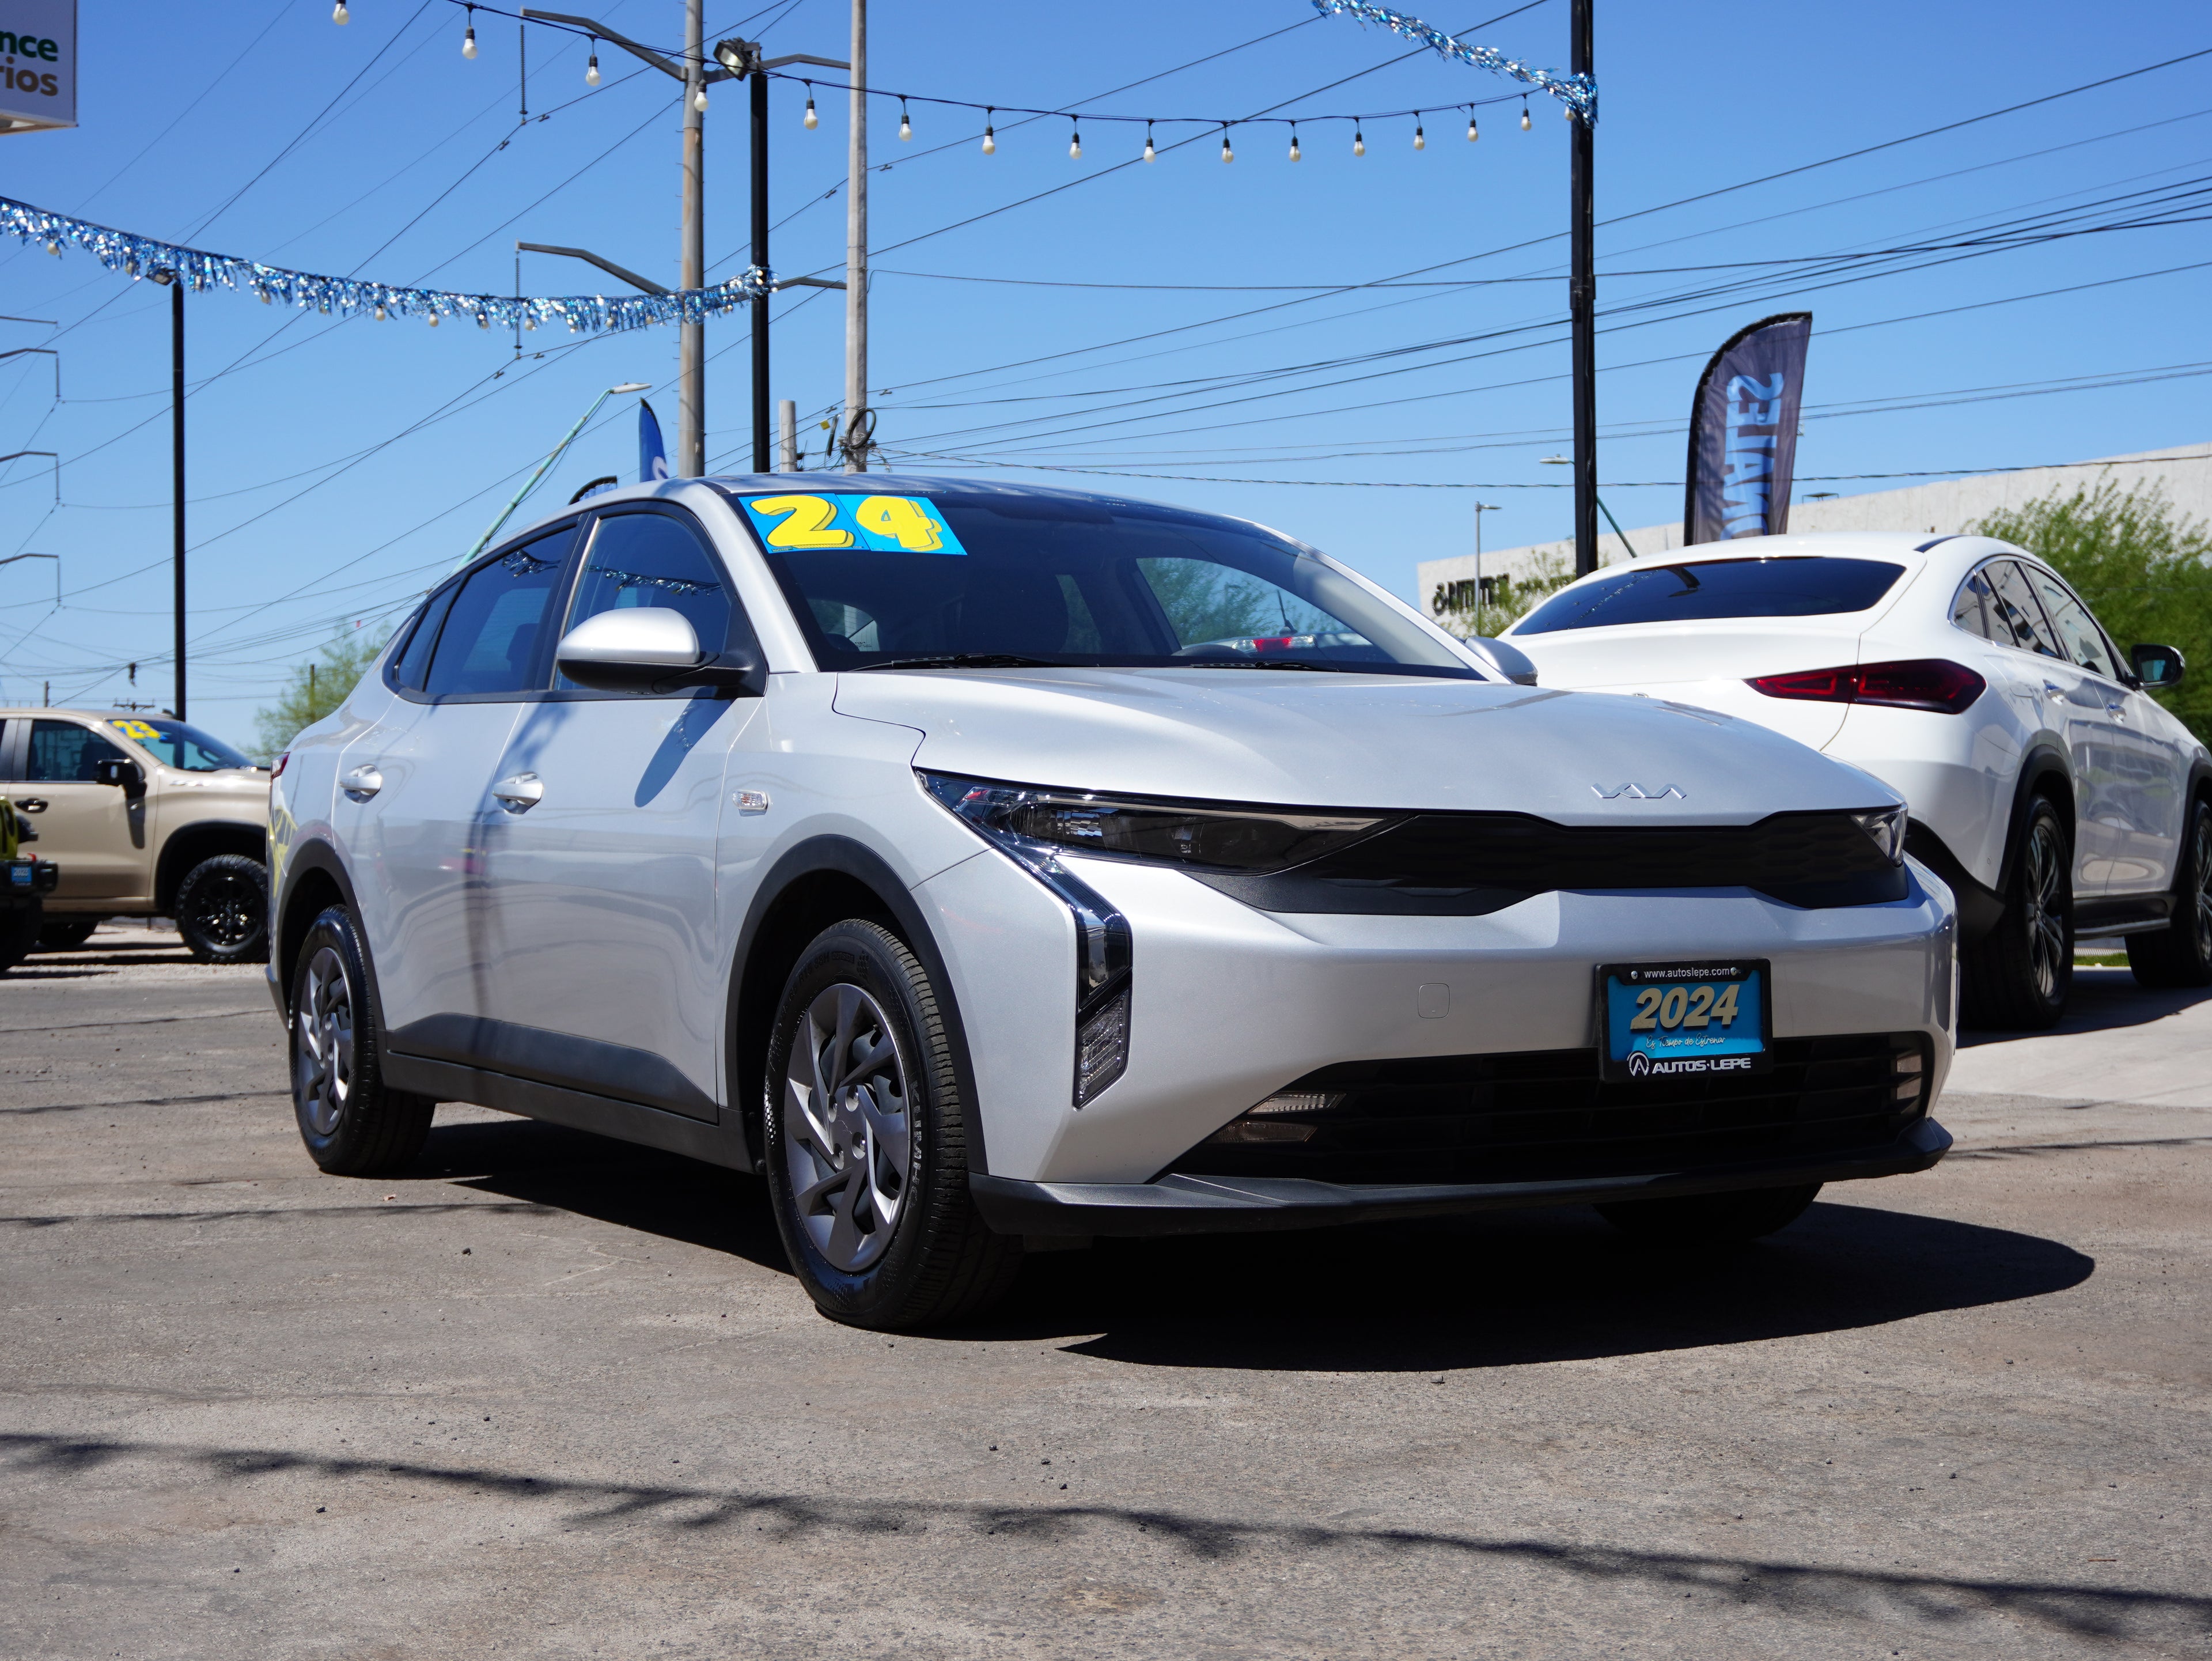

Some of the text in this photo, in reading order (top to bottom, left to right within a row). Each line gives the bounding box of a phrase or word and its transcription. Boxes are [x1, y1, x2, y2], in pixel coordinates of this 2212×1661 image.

[749, 494, 943, 551] 24
[112, 720, 161, 739] 23
[1644, 967, 1729, 978] www.autoslepe.com
[1630, 985, 1740, 1030] 2024
[1684, 1036, 1694, 1045] de
